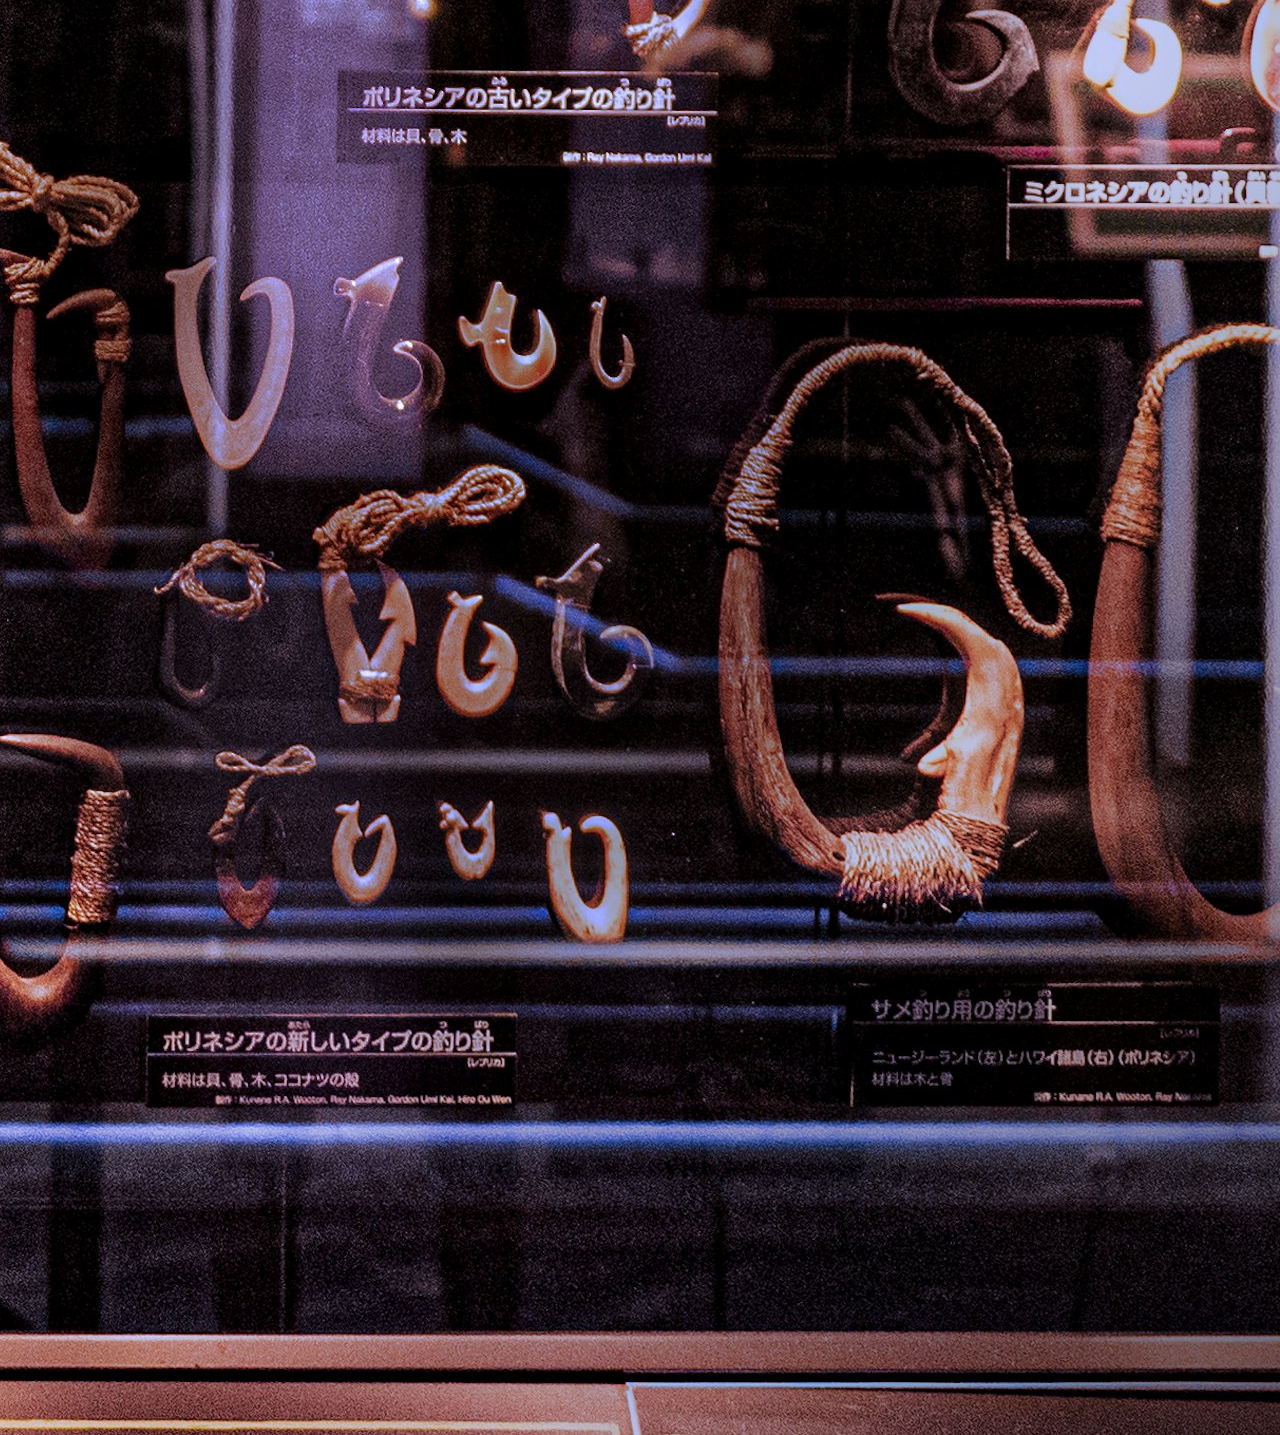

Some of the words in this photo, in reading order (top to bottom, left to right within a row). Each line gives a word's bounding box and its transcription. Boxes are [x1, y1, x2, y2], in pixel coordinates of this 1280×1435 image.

[362, 85, 676, 112] ポリネシアの古いタイプの釣り針
[361, 128, 468, 145] 材料は貝、骨、木
[871, 997, 1057, 1022] サメ釣り用の釣り針
[162, 1029, 494, 1053] ポリネシアの新しいタイプの釣り針
[162, 1072, 360, 1089] 材料は貝、骨、木、ココナツの殻
[871, 1071, 954, 1087] 材料は木と骨
